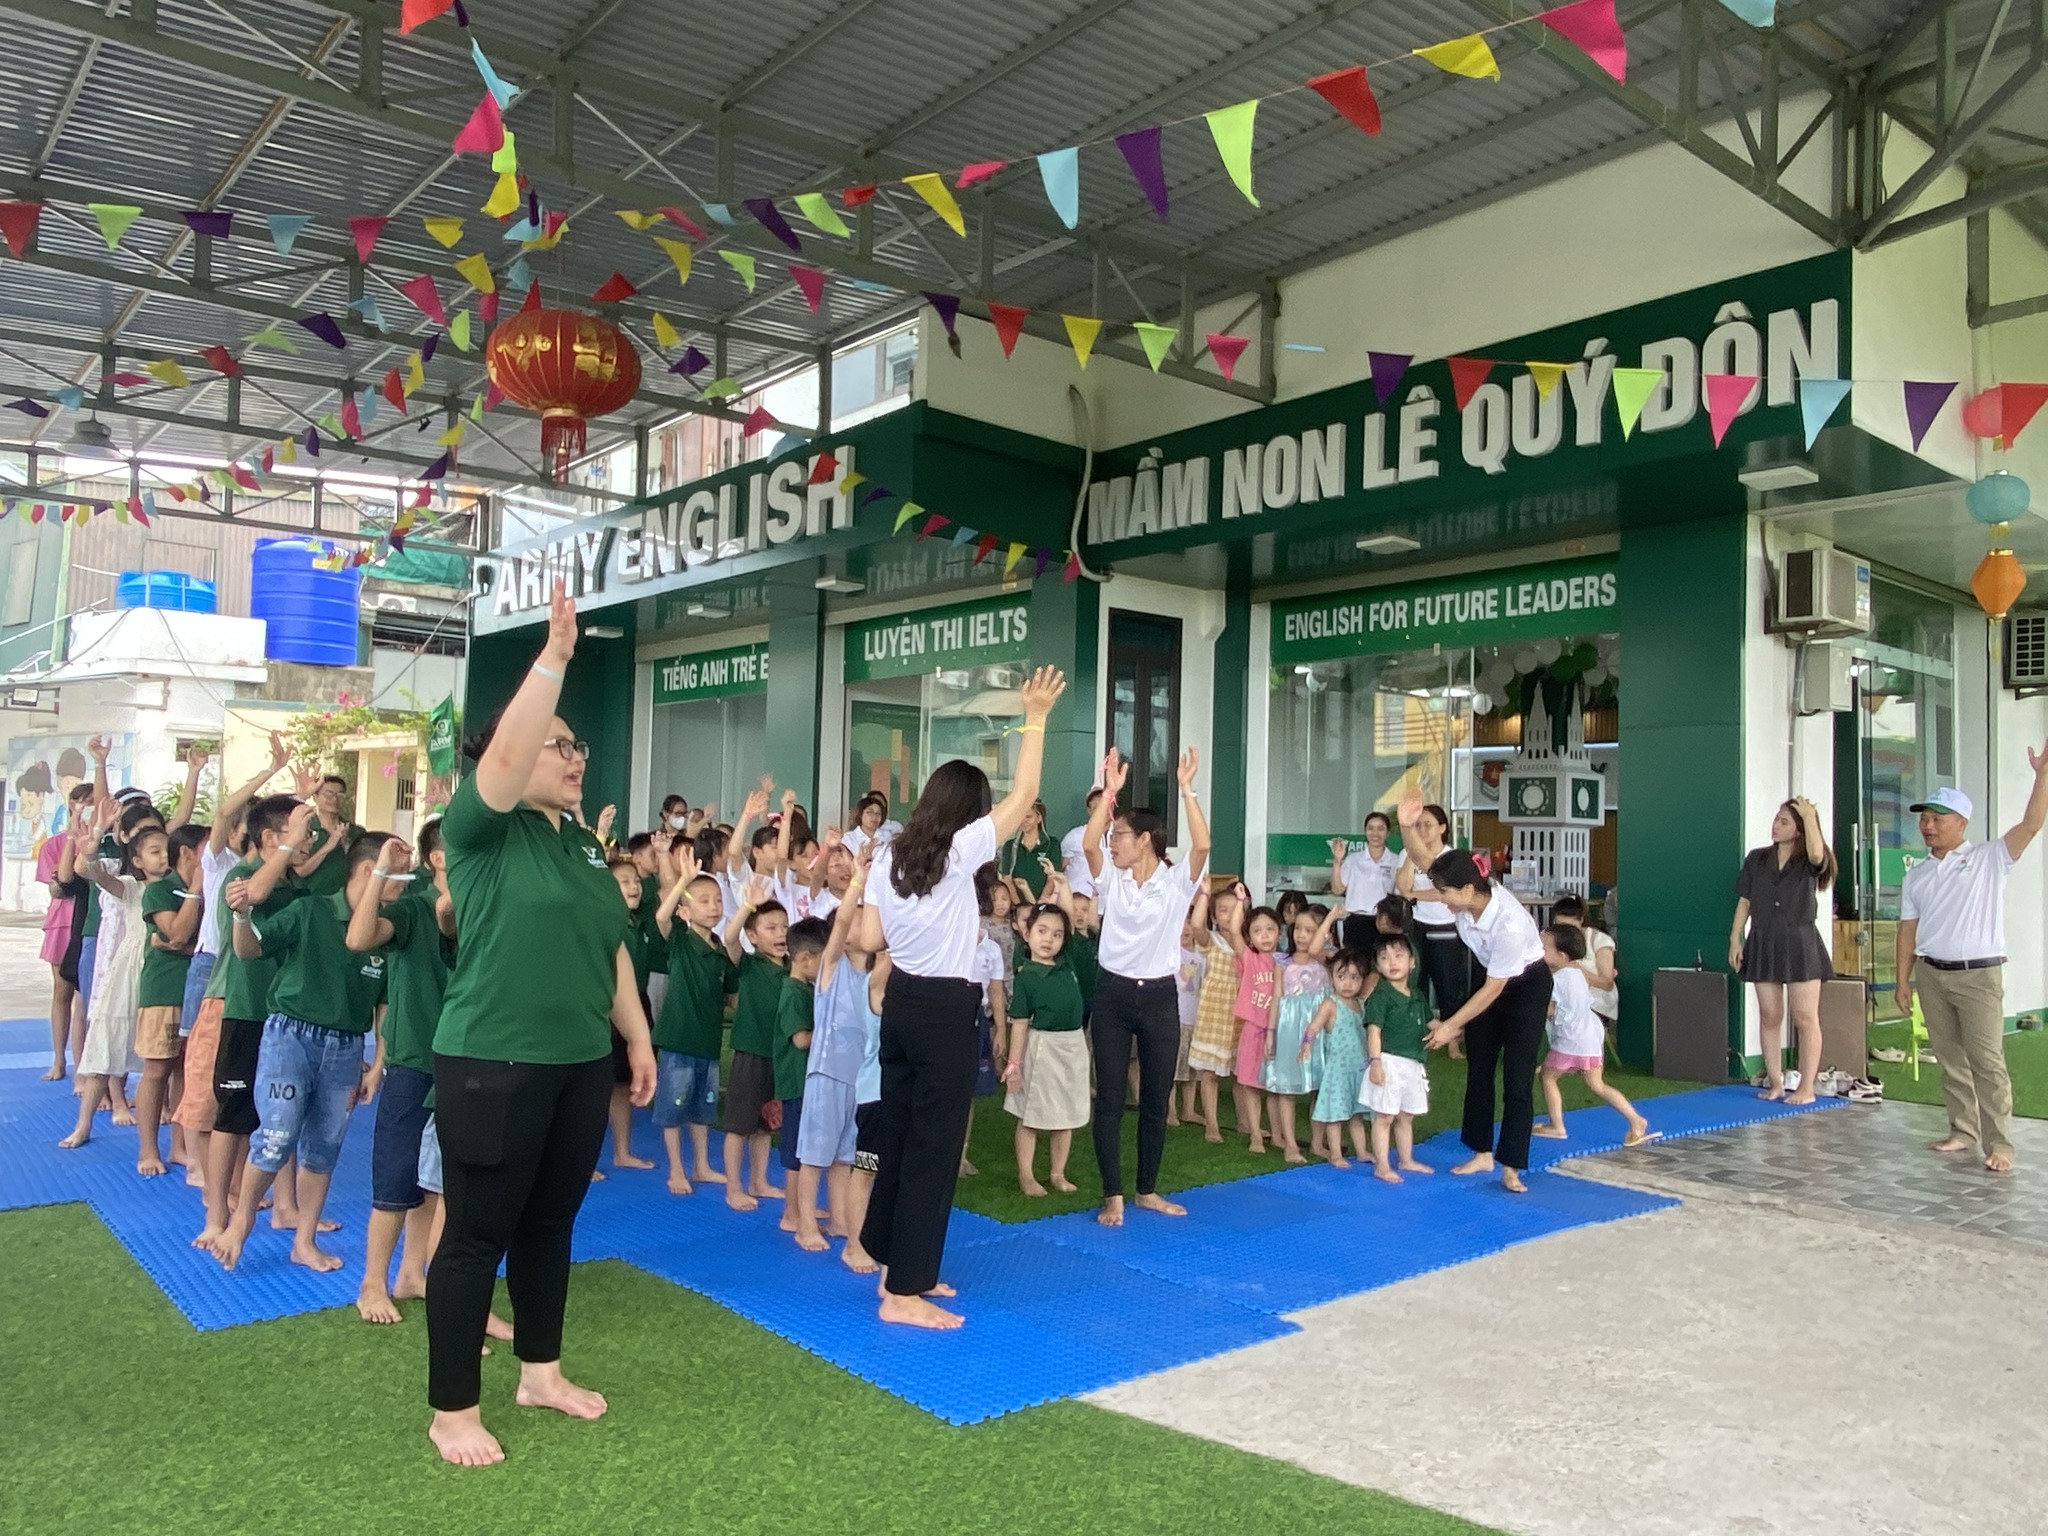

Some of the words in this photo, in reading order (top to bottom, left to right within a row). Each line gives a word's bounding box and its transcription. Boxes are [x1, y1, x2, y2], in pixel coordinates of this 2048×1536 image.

[1087, 446, 1210, 546] MẦM
[1222, 422, 1347, 519] NON
[1363, 384, 1441, 490] LÊ
[1461, 336, 1618, 475] QUÝ
[1639, 298, 1839, 434] ĐÔN
[494, 528, 616, 616] ARMY
[618, 445, 856, 584] ENGLISH
[931, 617, 964, 652] THI
[969, 606, 1028, 648] IELTS
[1285, 604, 1363, 642] ENGLISH
[1369, 600, 1408, 632] FOR
[1414, 588, 1498, 627] FUTURE
[1505, 573, 1617, 617] LEADERS
[662, 655, 698, 692] TIẾNG
[700, 658, 729, 687] ANH
[731, 644, 757, 684] TRẺ
[269, 1082, 296, 1101] NO
